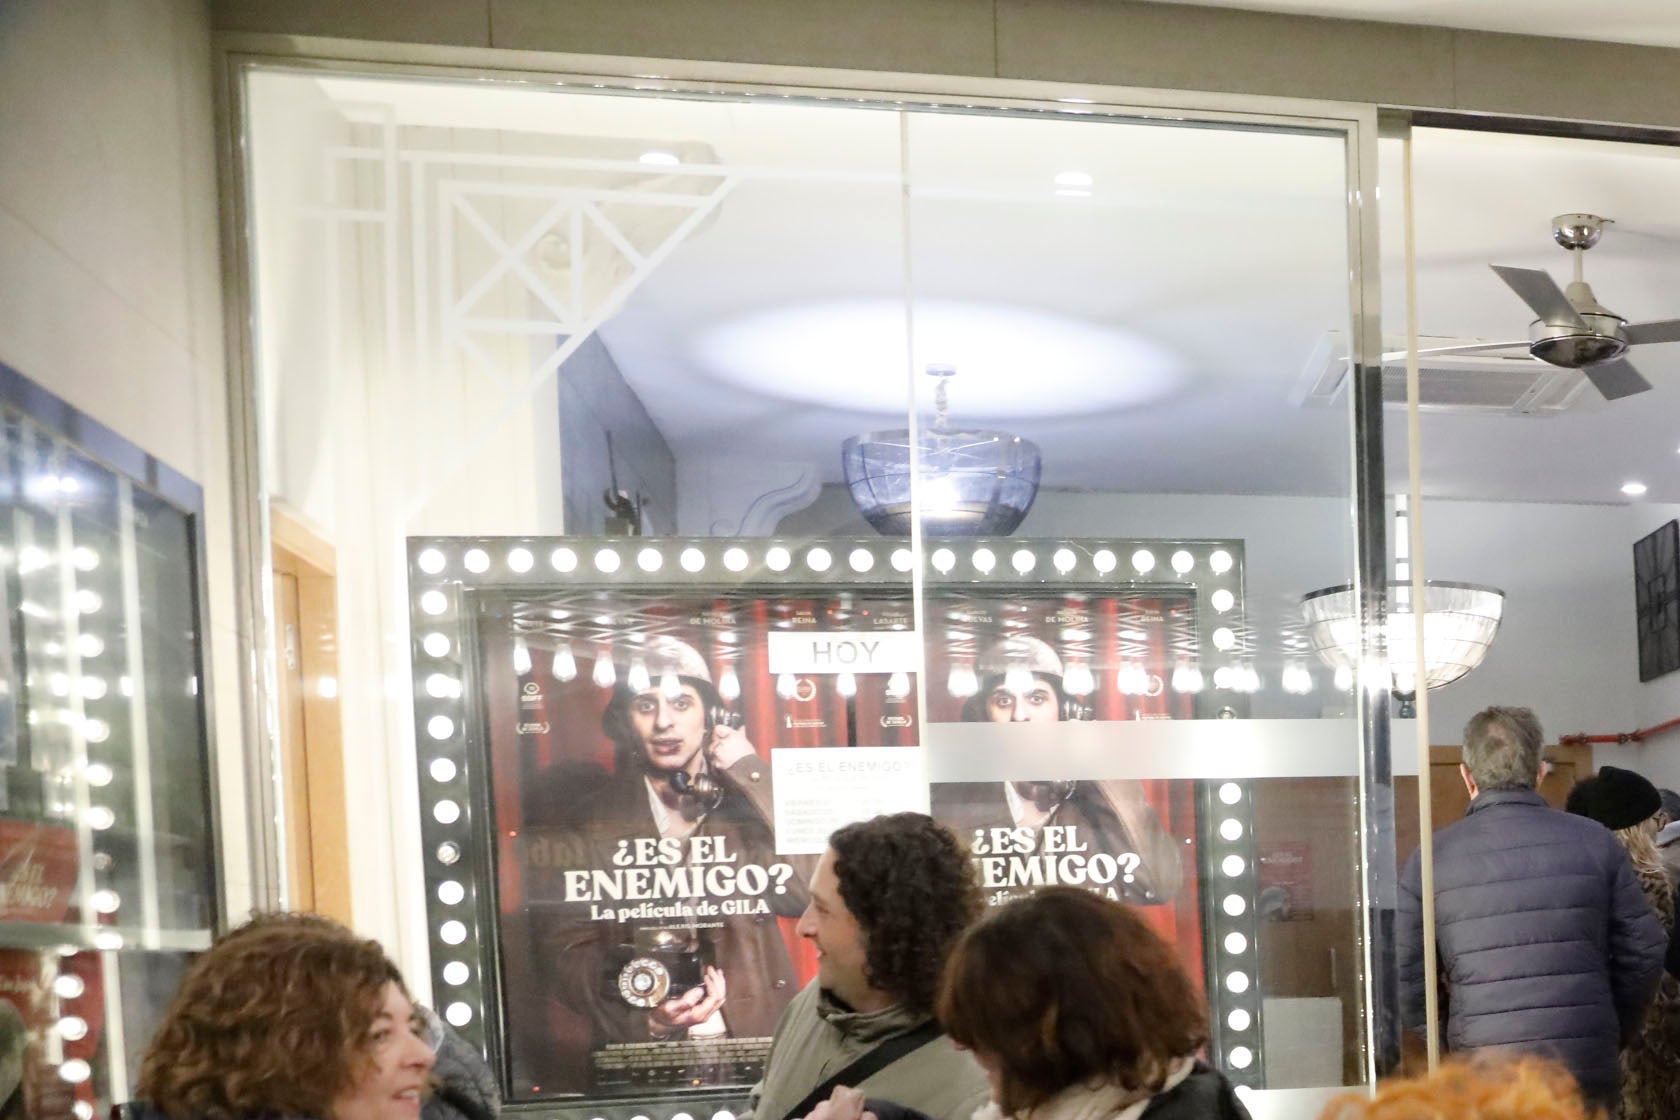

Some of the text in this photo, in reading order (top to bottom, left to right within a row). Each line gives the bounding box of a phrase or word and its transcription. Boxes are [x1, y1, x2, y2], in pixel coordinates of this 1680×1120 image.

[813, 641, 880, 665] HOY
[612, 835, 738, 867] ¿ES EL
[970, 825, 1088, 855] ¿ES EL
[563, 863, 794, 902] ENEMIGO?
[590, 899, 771, 923] La película de GILA
